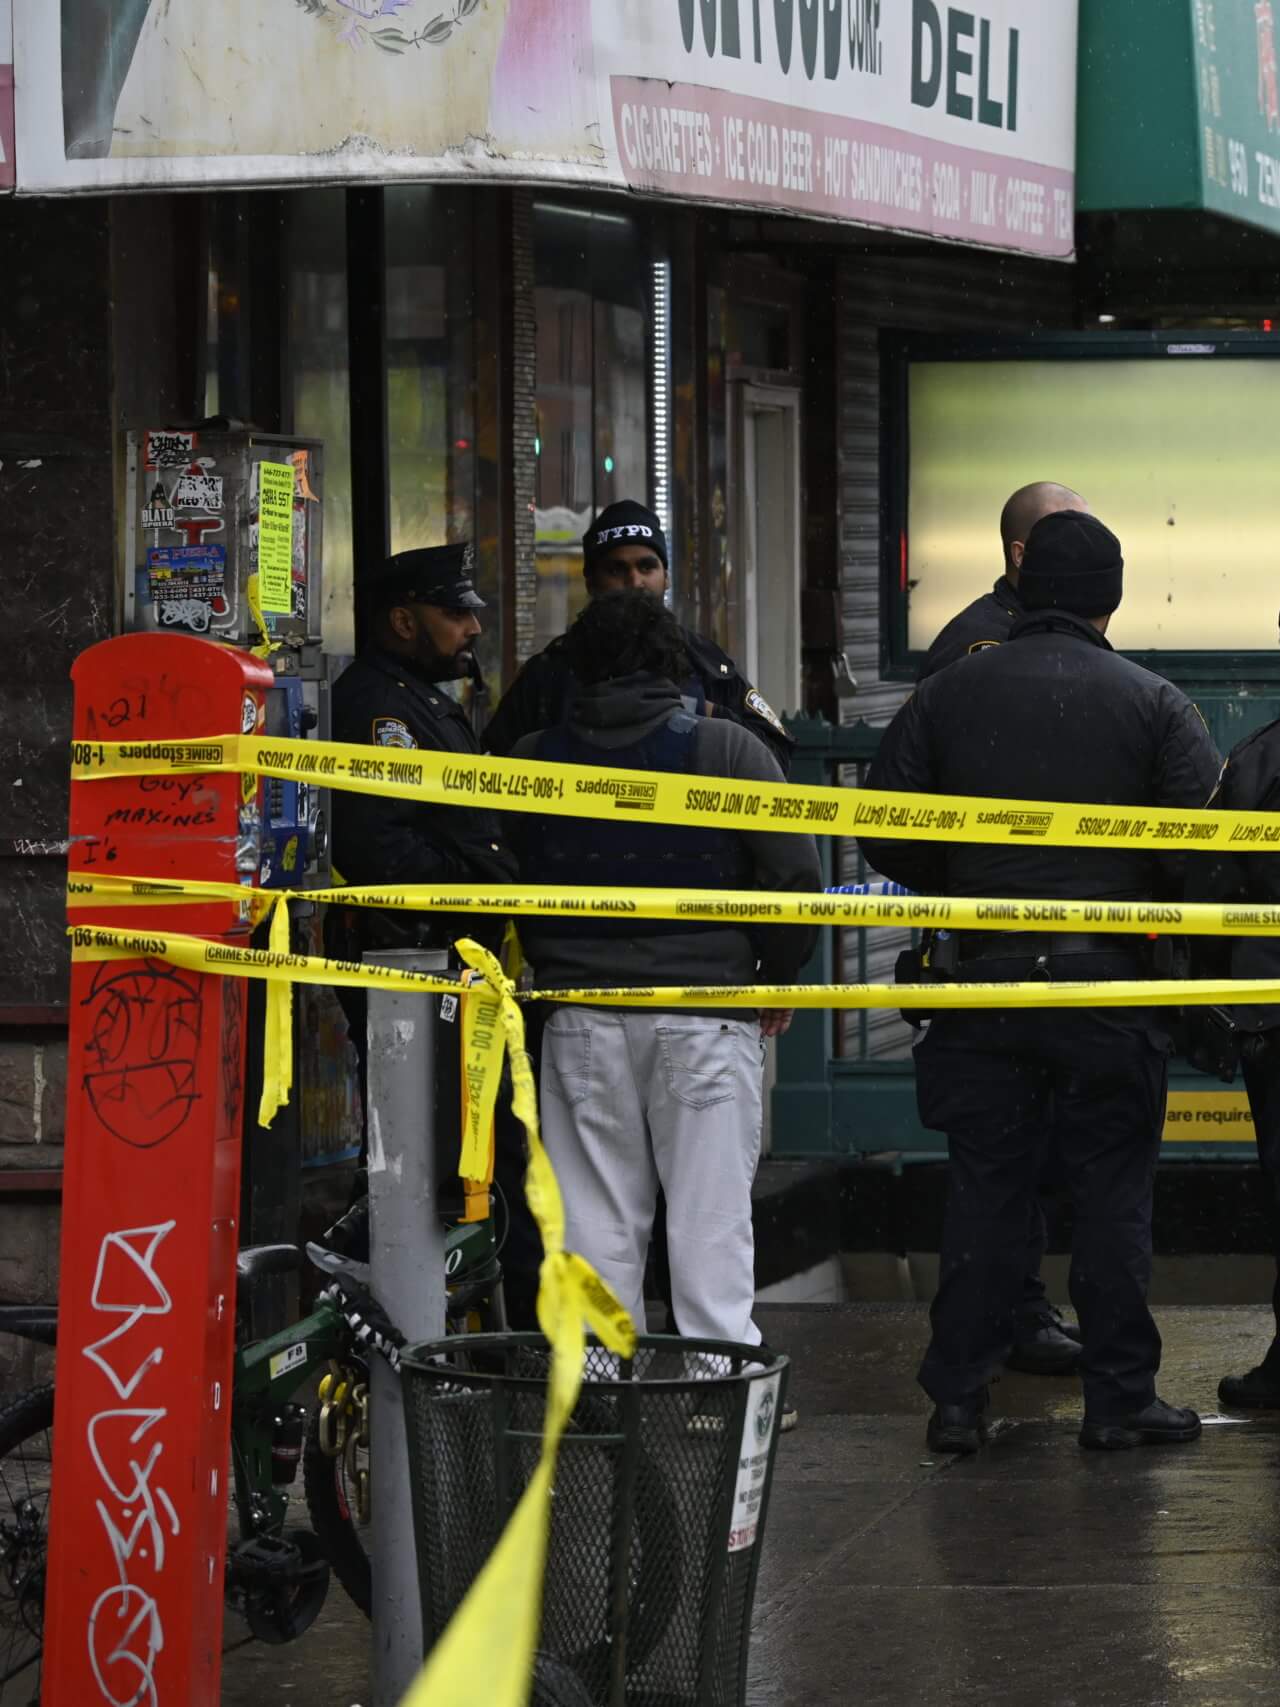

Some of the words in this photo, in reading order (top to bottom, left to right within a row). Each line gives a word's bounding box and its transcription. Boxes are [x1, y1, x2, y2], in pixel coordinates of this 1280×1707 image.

[911, 0, 1019, 131] DELI
[620, 103, 713, 176] CIGARETTES
[723, 117, 745, 181] ICE
[750, 124, 778, 186] COLD
[782, 129, 814, 193] BEER
[824, 136, 848, 198] HOT
[851, 140, 922, 211] SANDWICHES
[932, 162, 961, 221] SODA
[970, 170, 998, 227] MILK
[1005, 177, 1044, 237] COFFEE
[1054, 187, 1073, 241] TEA
[597, 525, 653, 545] NYPD
[320, 756, 336, 774] DO
[348, 758, 384, 781] SCENE
[387, 762, 422, 785] CRIME
[443, 766, 477, 794] (8477)
[480, 772, 564, 799] 1-800-577-TIPS
[686, 788, 718, 812] CROSS
[721, 793, 743, 814] NOT
[745, 795, 760, 816] DO
[770, 797, 804, 819] SCENE
[804, 800, 838, 822] CRIME
[854, 803, 888, 827] (8477)
[887, 807, 966, 829] 1-800-577-TIPS
[1076, 817, 1110, 836] CROSS
[1108, 818, 1129, 836] NOT
[1130, 820, 1147, 837] DO
[1153, 821, 1187, 839] SCENE
[1185, 823, 1218, 839] CRIME
[1229, 824, 1262, 842] (8477)
[798, 903, 904, 917] 1-800-577-TIPS
[908, 904, 951, 920] (8477)
[976, 906, 1020, 920] CRIME
[1024, 906, 1068, 921] SCENE
[1084, 908, 1105, 922] DO
[1108, 908, 1132, 922] NOT
[1138, 909, 1182, 924] CROSS
[1167, 1110, 1192, 1122] are
